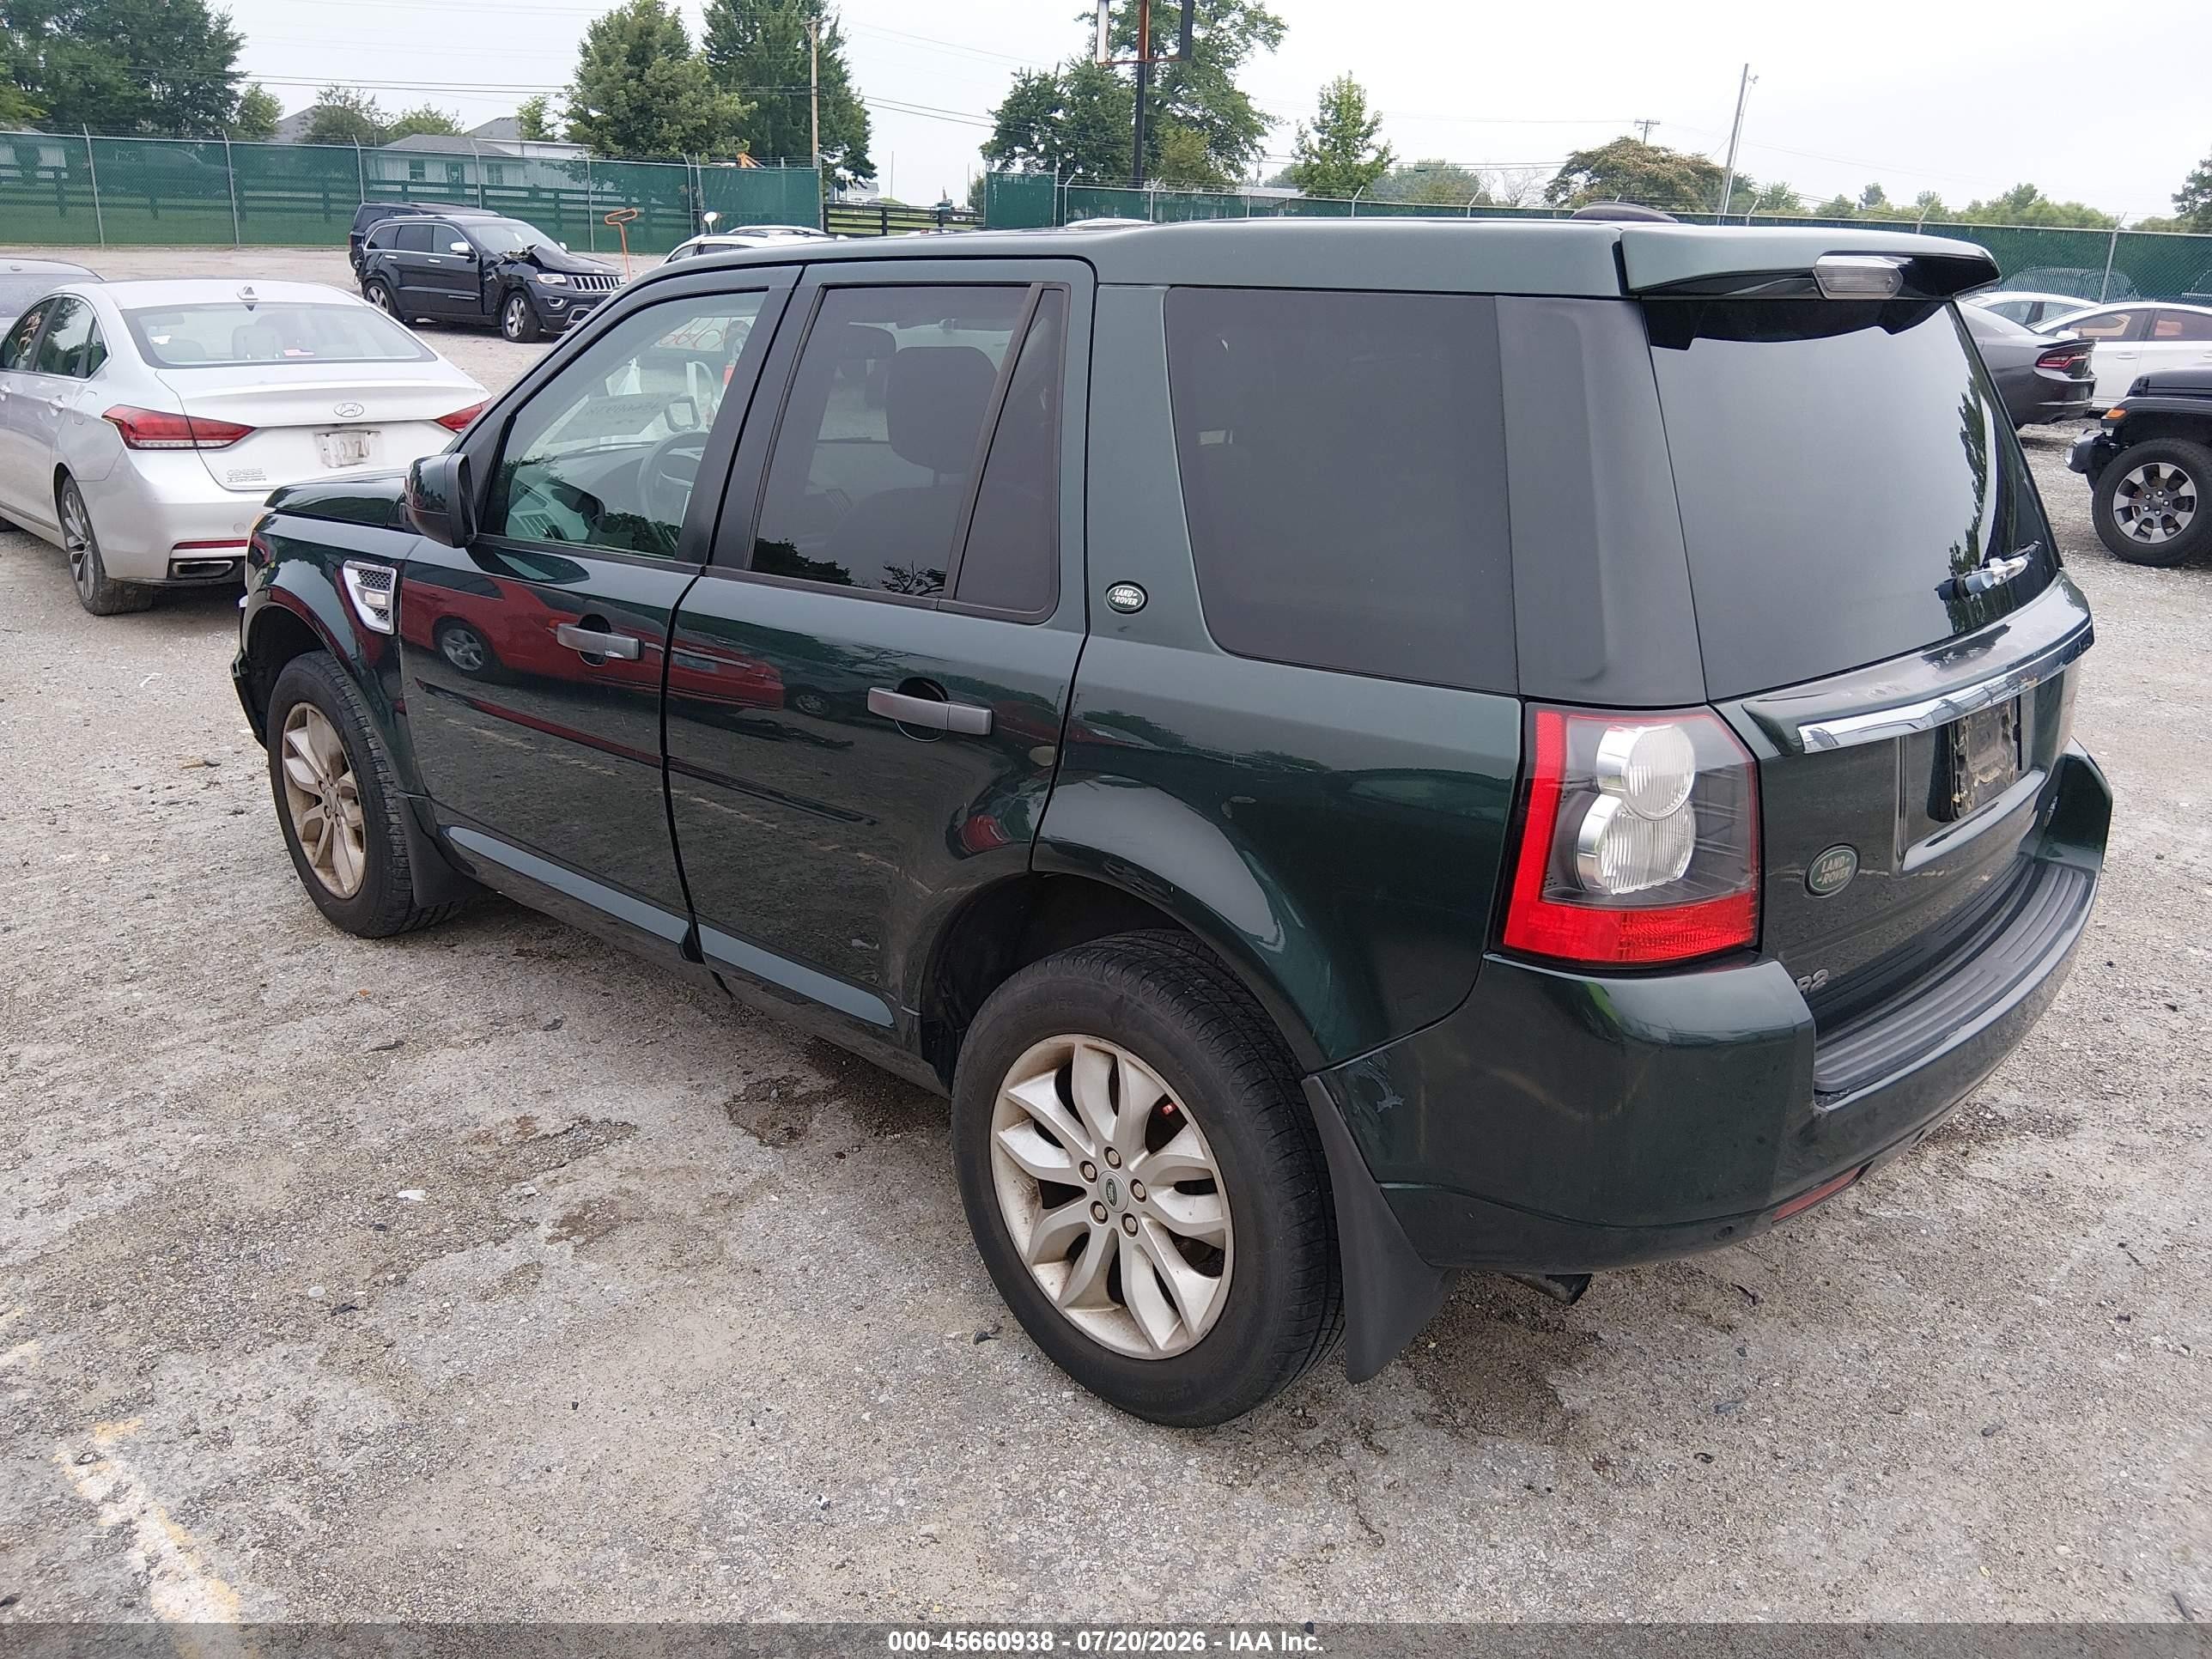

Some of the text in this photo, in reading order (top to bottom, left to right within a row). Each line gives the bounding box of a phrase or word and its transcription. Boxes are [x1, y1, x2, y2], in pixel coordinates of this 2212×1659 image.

[1115, 588, 1134, 598] LAND
[1115, 596, 1139, 606] ROVER
[1821, 856, 1845, 873] LAND
[1821, 866, 1850, 885] ROVER
